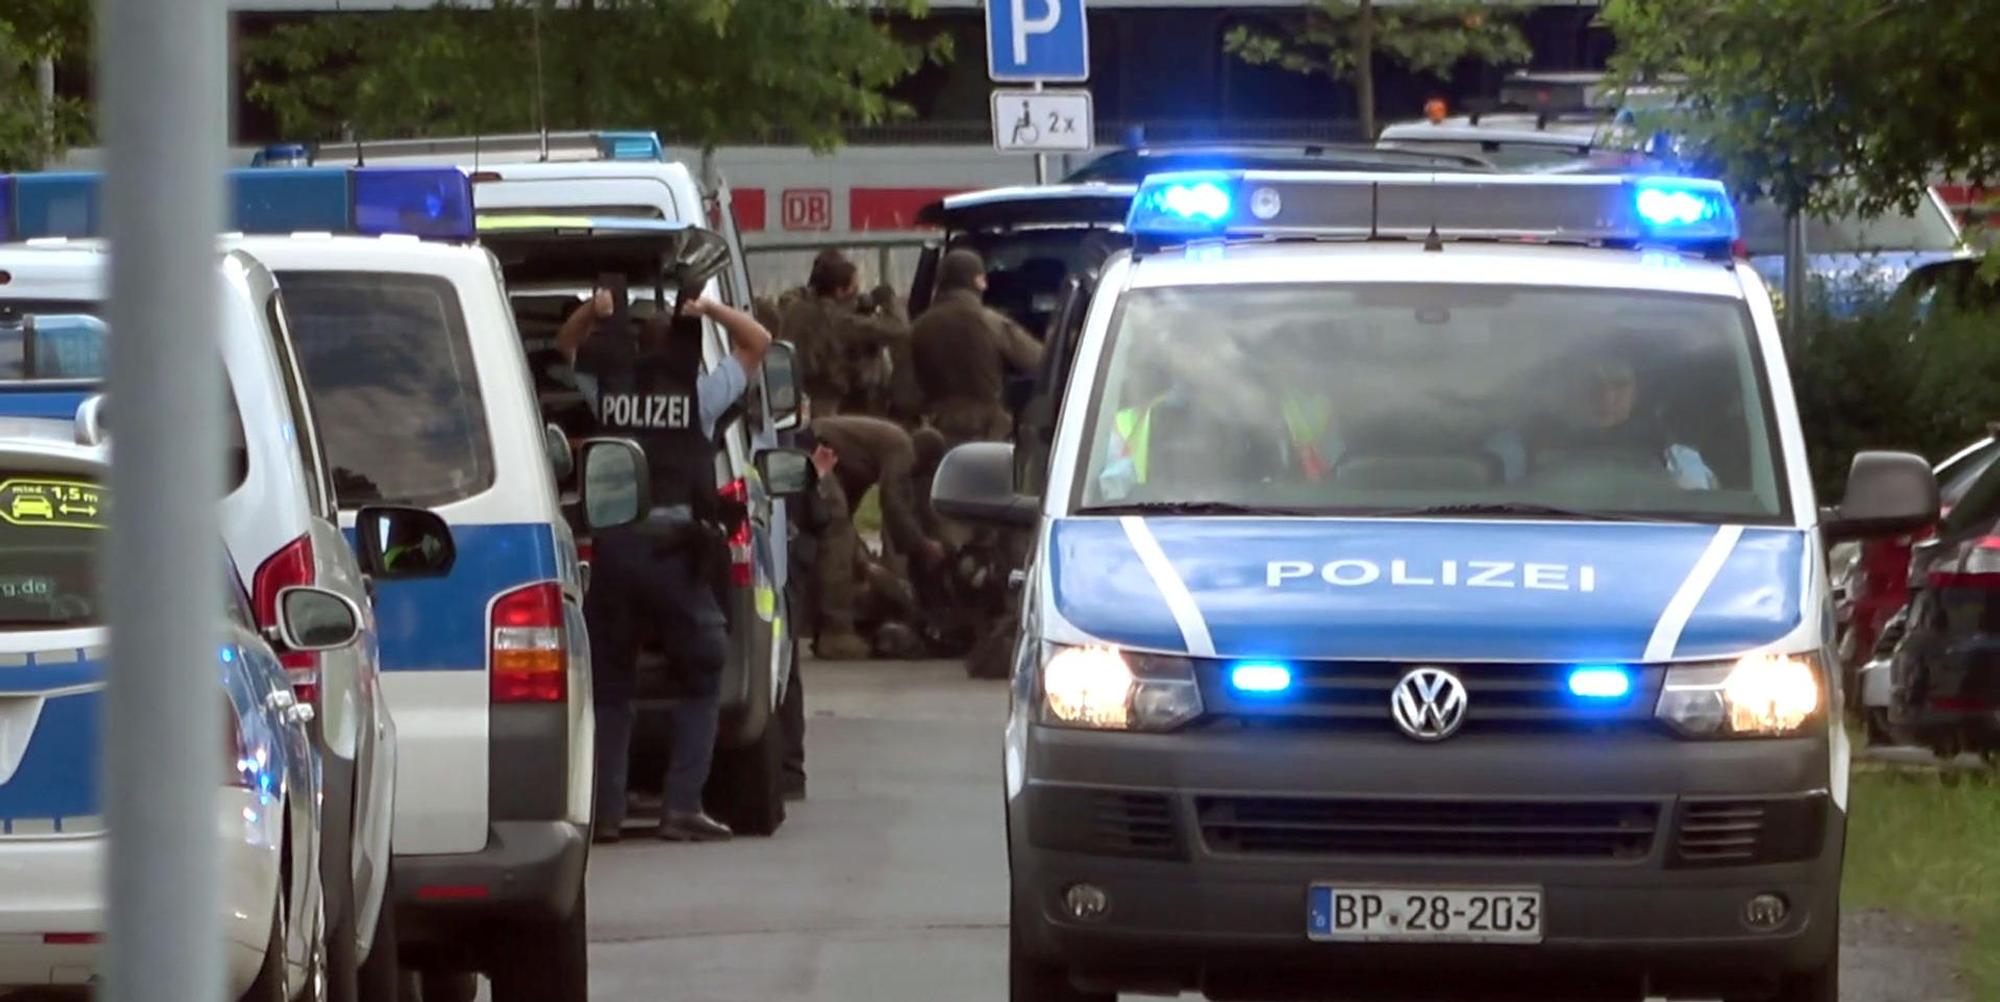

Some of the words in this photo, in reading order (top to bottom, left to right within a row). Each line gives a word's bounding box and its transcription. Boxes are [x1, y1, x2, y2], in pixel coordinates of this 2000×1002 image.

[1011, 0, 1061, 65] P
[1048, 112, 1058, 132] 2
[789, 197, 825, 221] DB
[602, 394, 690, 428] POLIZEI
[52, 486, 80, 501] 1,5
[83, 493, 98, 502] m
[0, 579, 47, 597] g.de
[1266, 560, 1595, 592] POLIZEI
